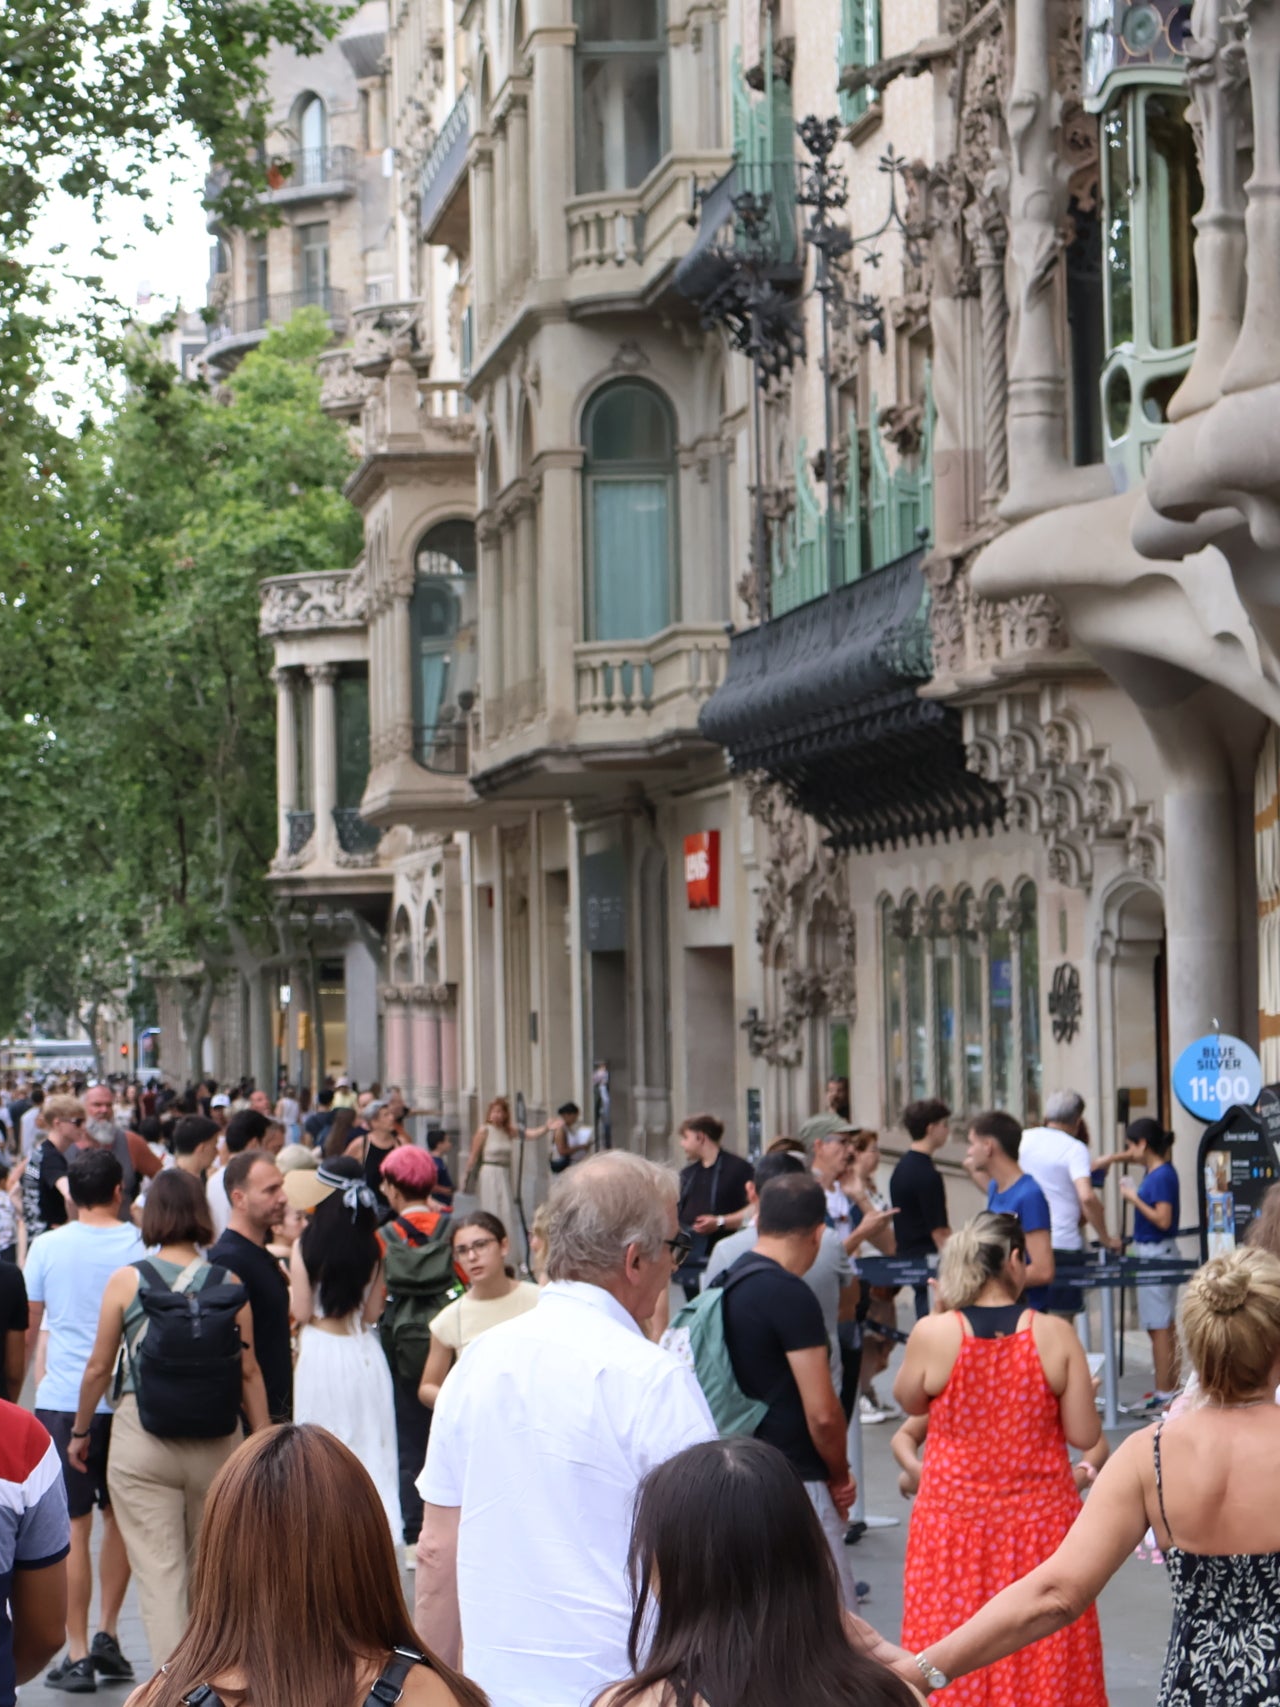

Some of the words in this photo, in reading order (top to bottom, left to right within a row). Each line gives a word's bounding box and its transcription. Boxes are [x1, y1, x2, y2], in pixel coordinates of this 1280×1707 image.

[1202, 1047, 1236, 1058] BLUE
[1197, 1060, 1242, 1071] SILVER
[1189, 1076, 1250, 1102] 11:00
